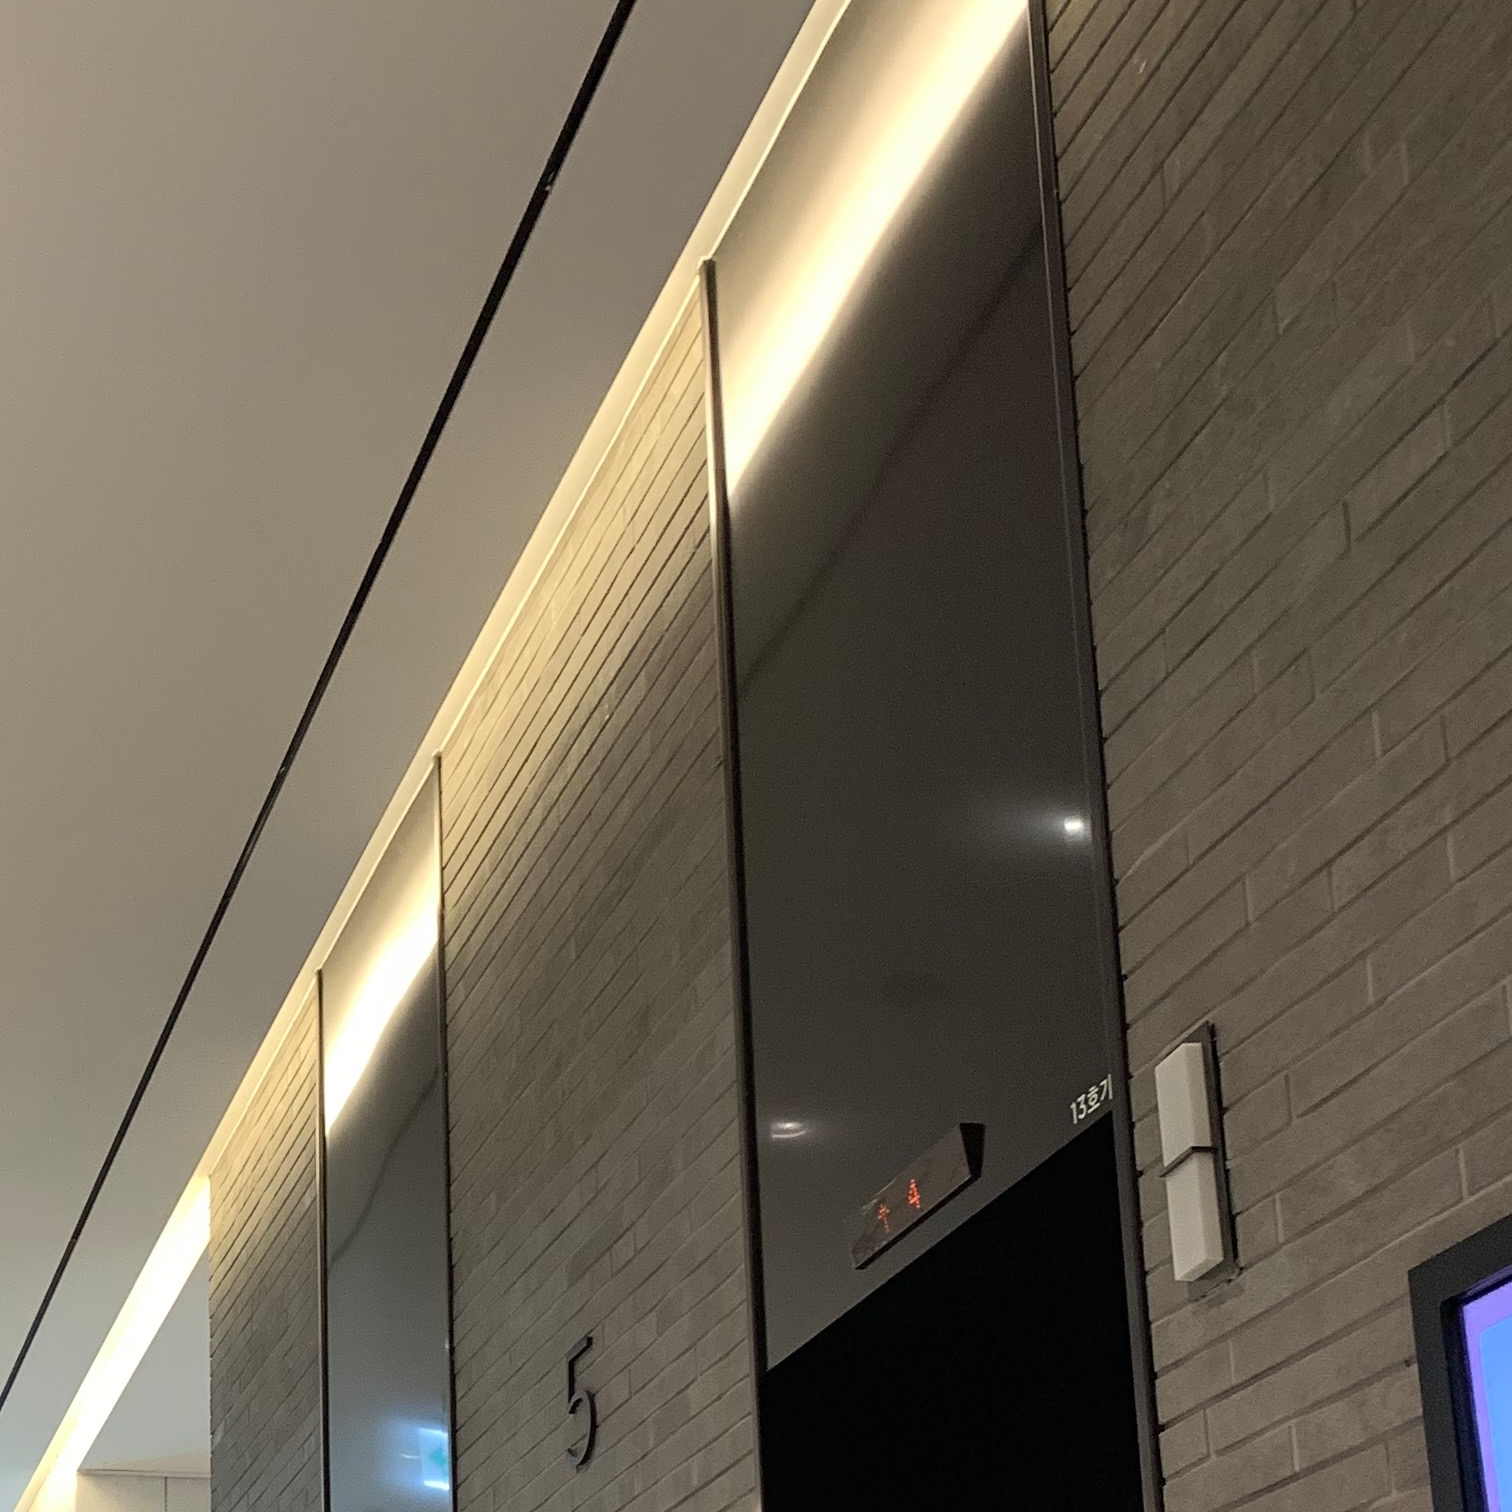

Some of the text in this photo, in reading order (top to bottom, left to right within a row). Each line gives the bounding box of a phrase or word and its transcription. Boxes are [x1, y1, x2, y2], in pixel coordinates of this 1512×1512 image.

[1070, 1073, 1113, 1125] 13호기
[907, 1178, 921, 1209] 4
[565, 1335, 599, 1473] 5
